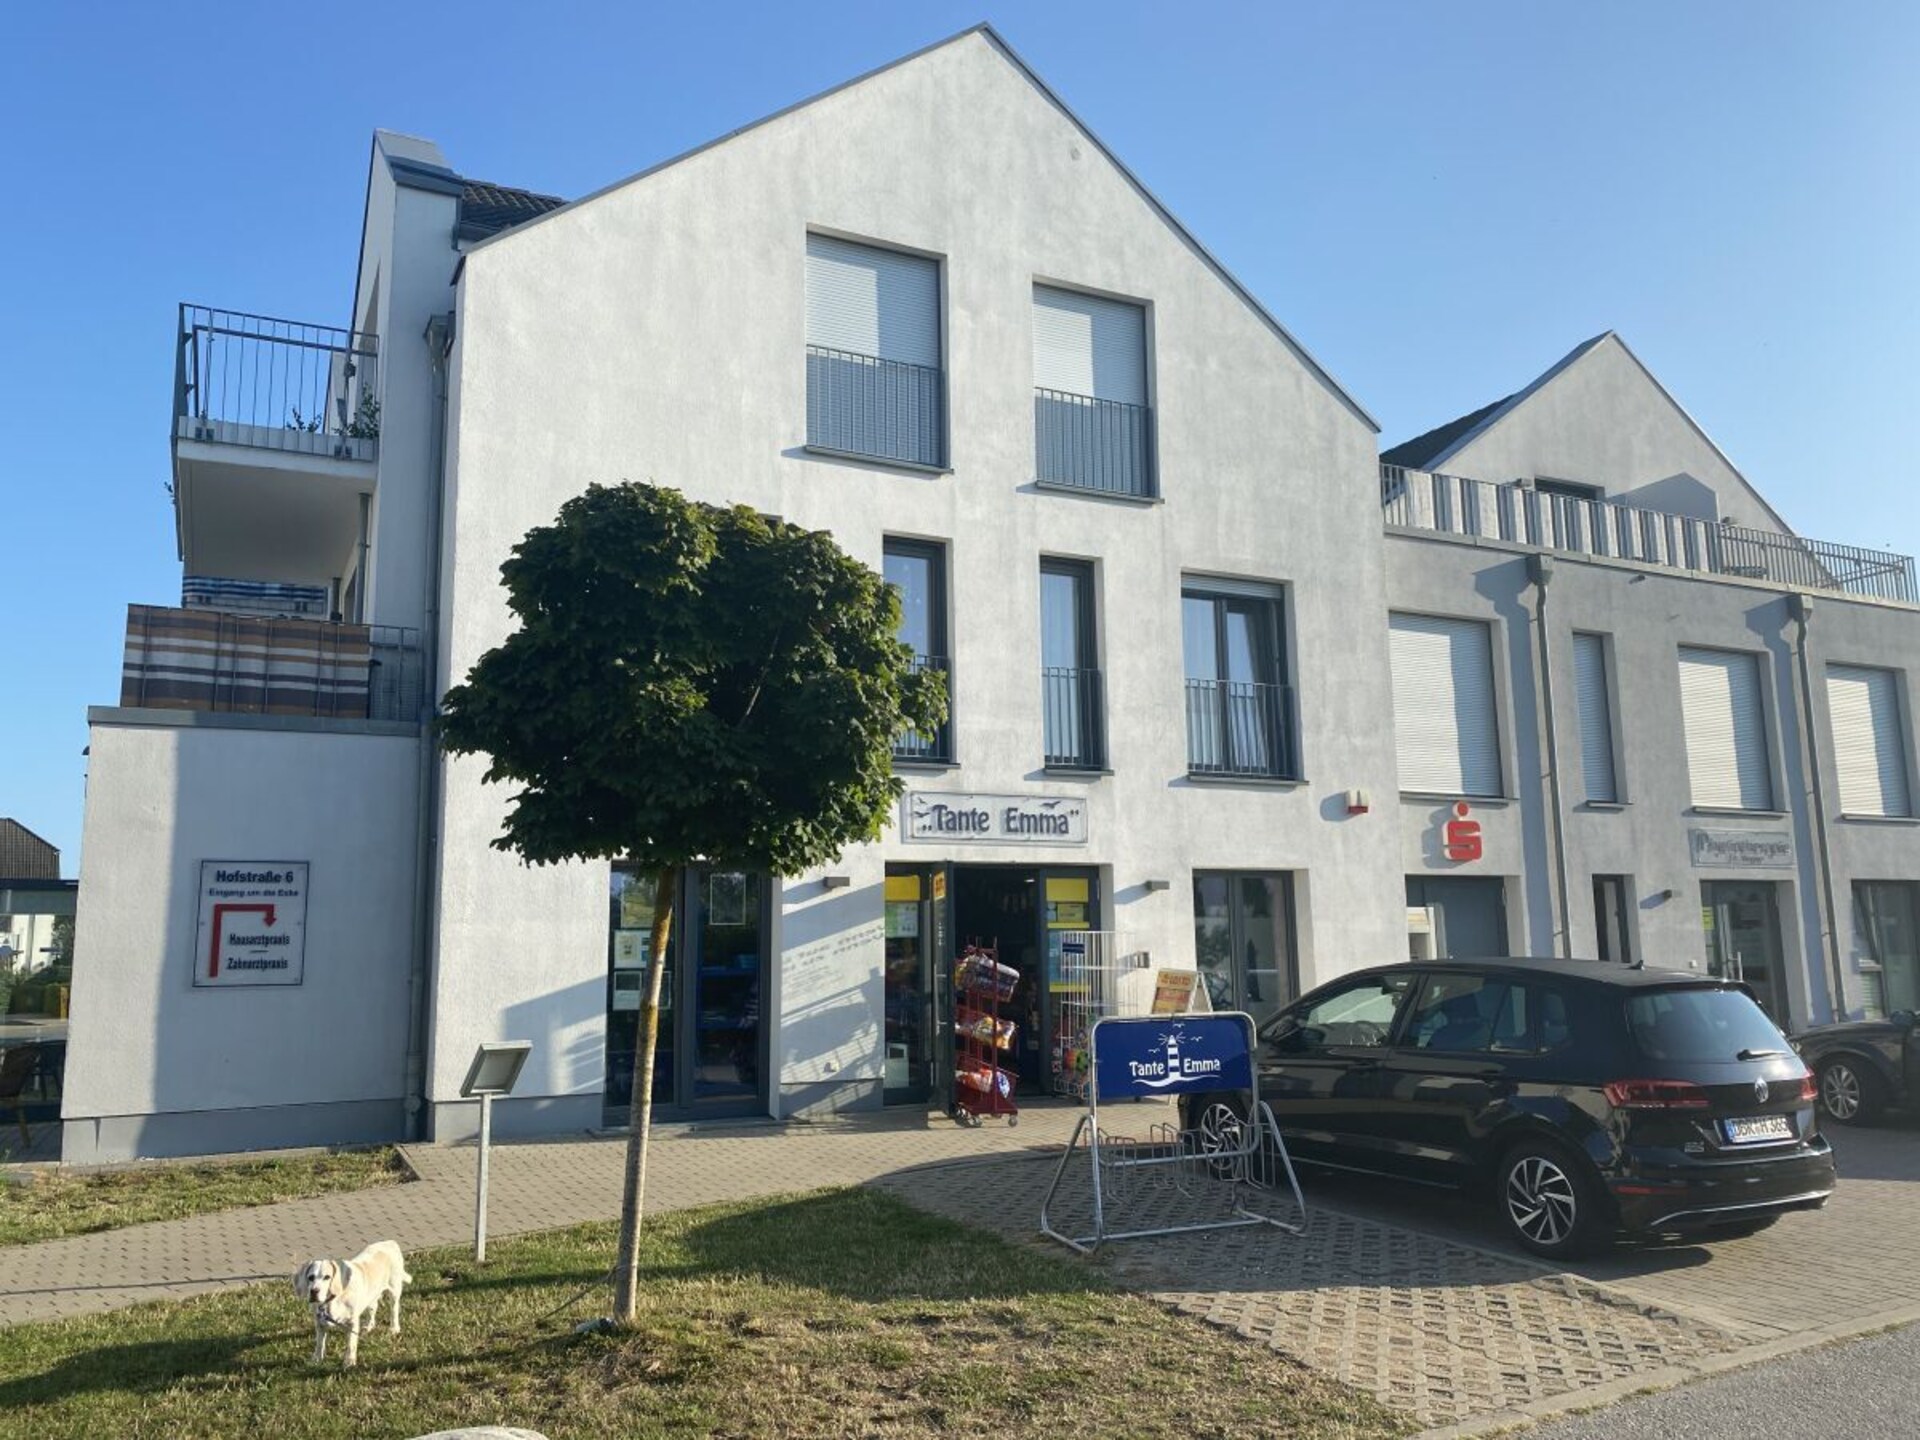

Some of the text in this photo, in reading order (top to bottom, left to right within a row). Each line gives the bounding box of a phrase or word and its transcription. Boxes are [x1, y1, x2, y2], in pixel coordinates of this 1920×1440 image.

[216, 870, 294, 883] Hofstraße 6
[229, 934, 290, 947] Hausarztpraxis
[227, 957, 288, 971] Zahnarztpraxis
[1129, 1057, 1221, 1077] Tante Emma
